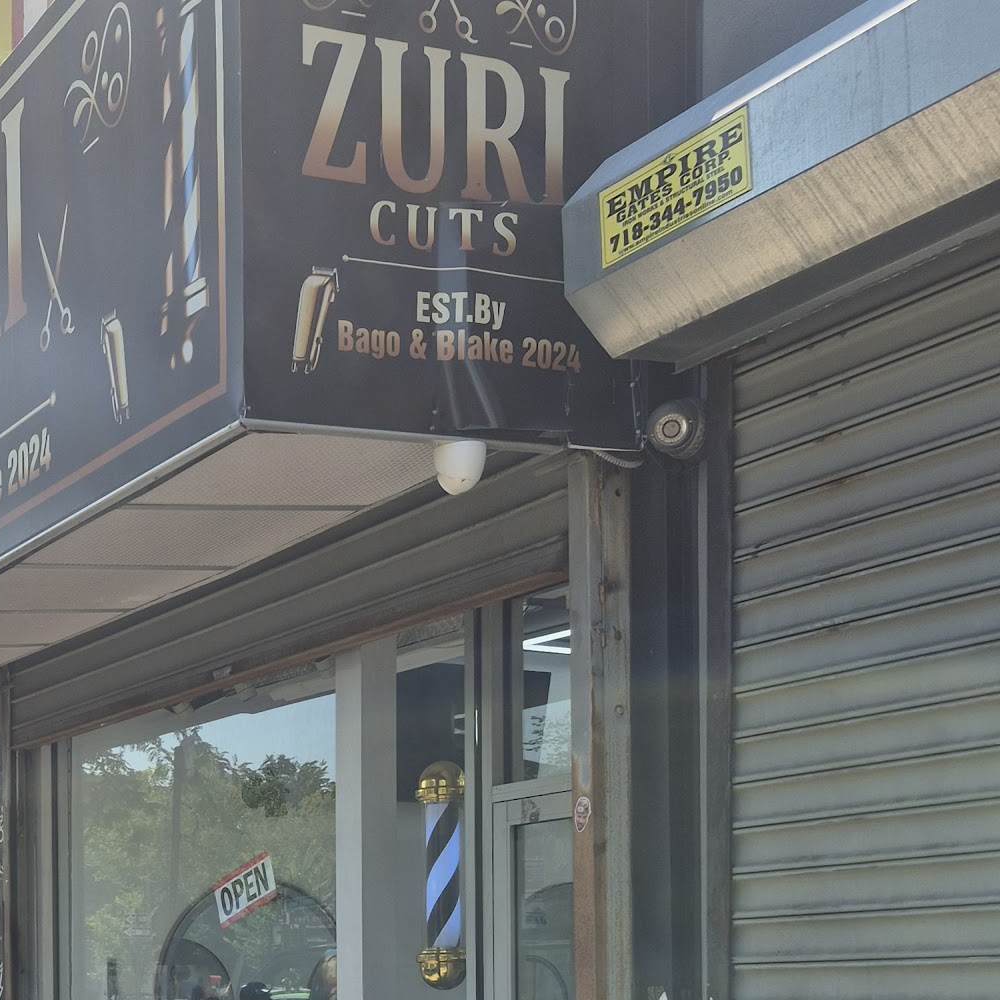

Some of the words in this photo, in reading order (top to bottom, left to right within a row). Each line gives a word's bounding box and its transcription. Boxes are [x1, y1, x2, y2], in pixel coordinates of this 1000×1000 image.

[301, 23, 570, 206] ZURI
[606, 122, 743, 219] EMPIRE
[616, 183, 673, 223] GATES
[679, 150, 731, 187] CORP.
[622, 216, 637, 228] IRON
[637, 203, 659, 218] WORKS
[665, 177, 705, 203] STRUCTURAL
[706, 166, 725, 180] STEEL
[369, 199, 519, 257] CUTS
[609, 165, 743, 253] 718-344-7950
[416, 291, 507, 331] EST.By
[337, 319, 400, 360] Bago
[409, 327, 427, 361] &
[436, 329, 514, 365] Blake
[522, 336, 582, 374] 2024
[7, 427, 52, 496] 2024
[220, 862, 270, 917] OPEN
